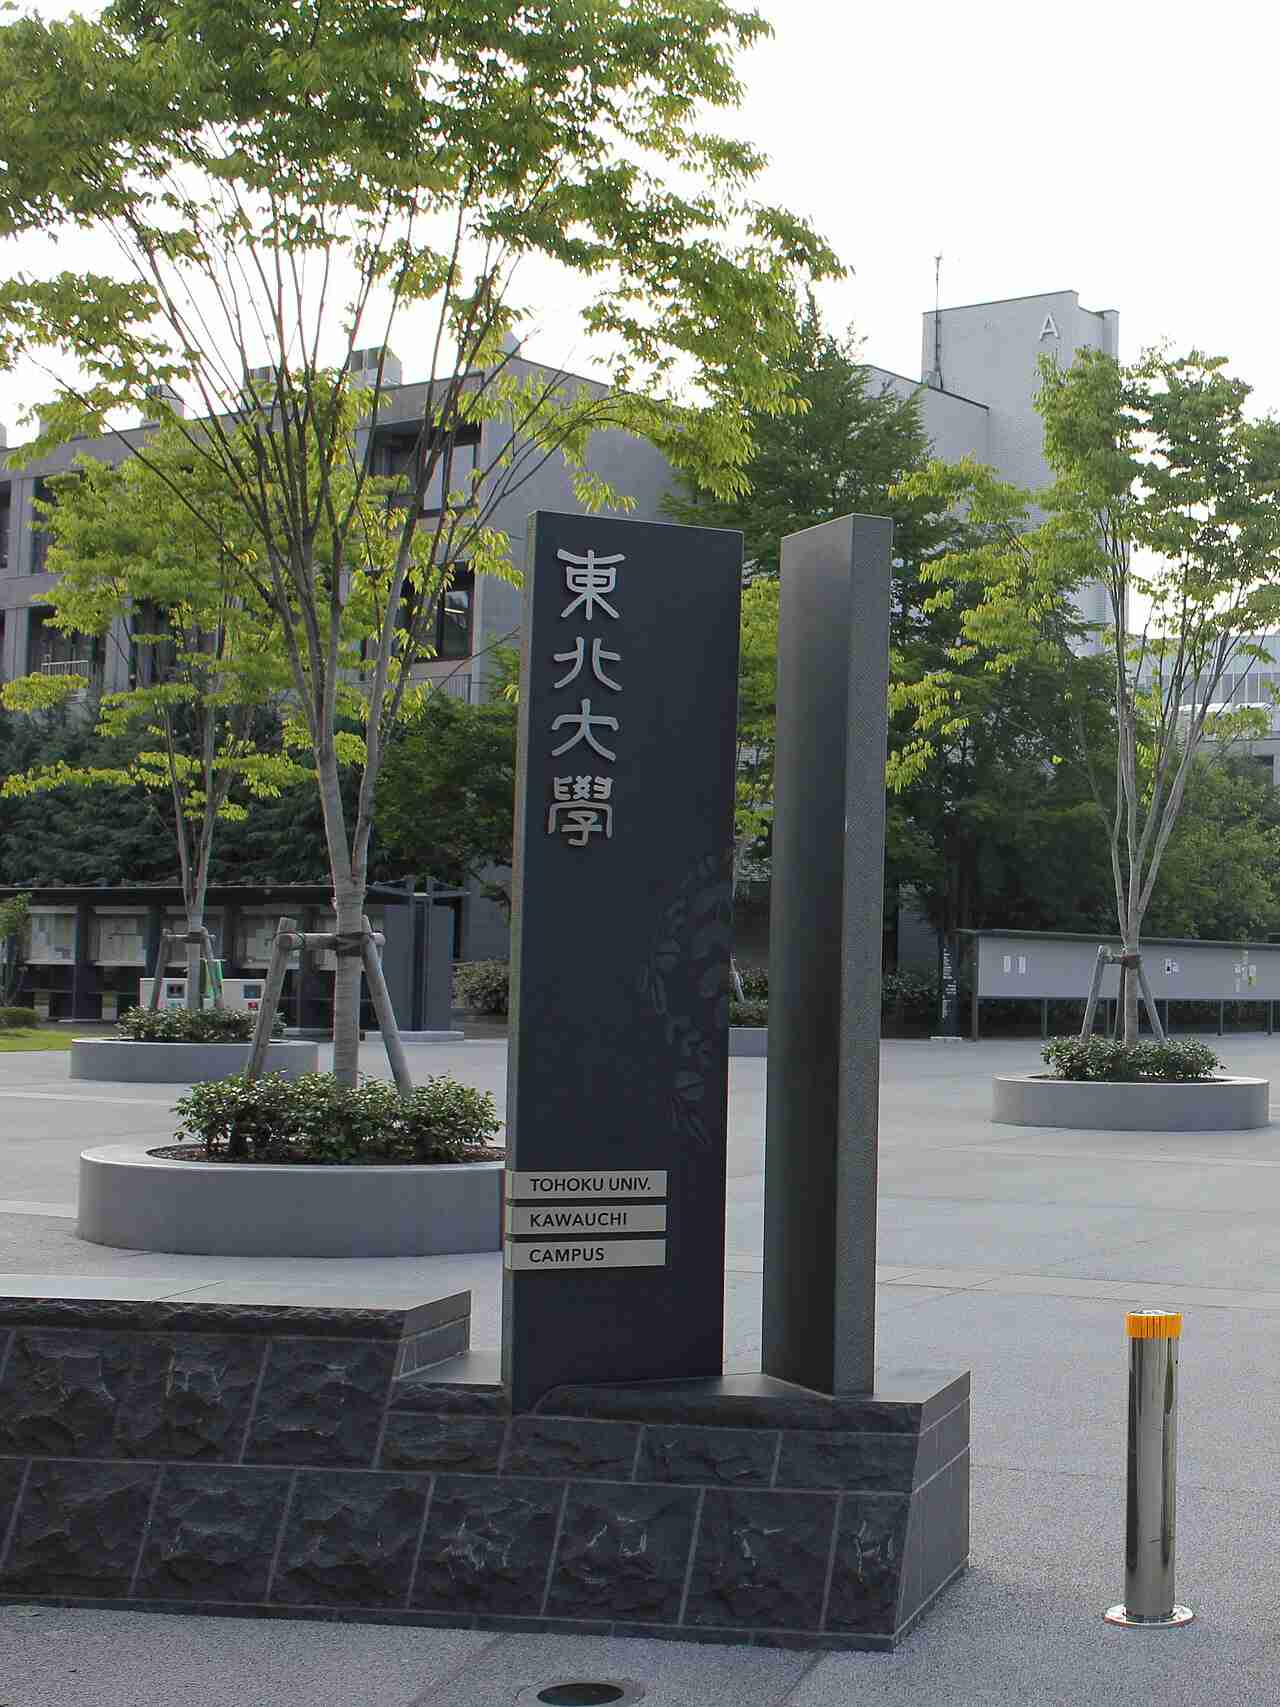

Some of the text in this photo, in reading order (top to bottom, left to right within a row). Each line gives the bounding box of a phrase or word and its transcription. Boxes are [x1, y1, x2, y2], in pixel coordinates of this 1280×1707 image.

[1039, 312, 1061, 342] A
[547, 548, 626, 847] 東北大學
[530, 1176, 652, 1192] TOHOKU UNIV.
[530, 1212, 628, 1228] KAWAUCHI
[529, 1247, 605, 1263] CAMPUS
